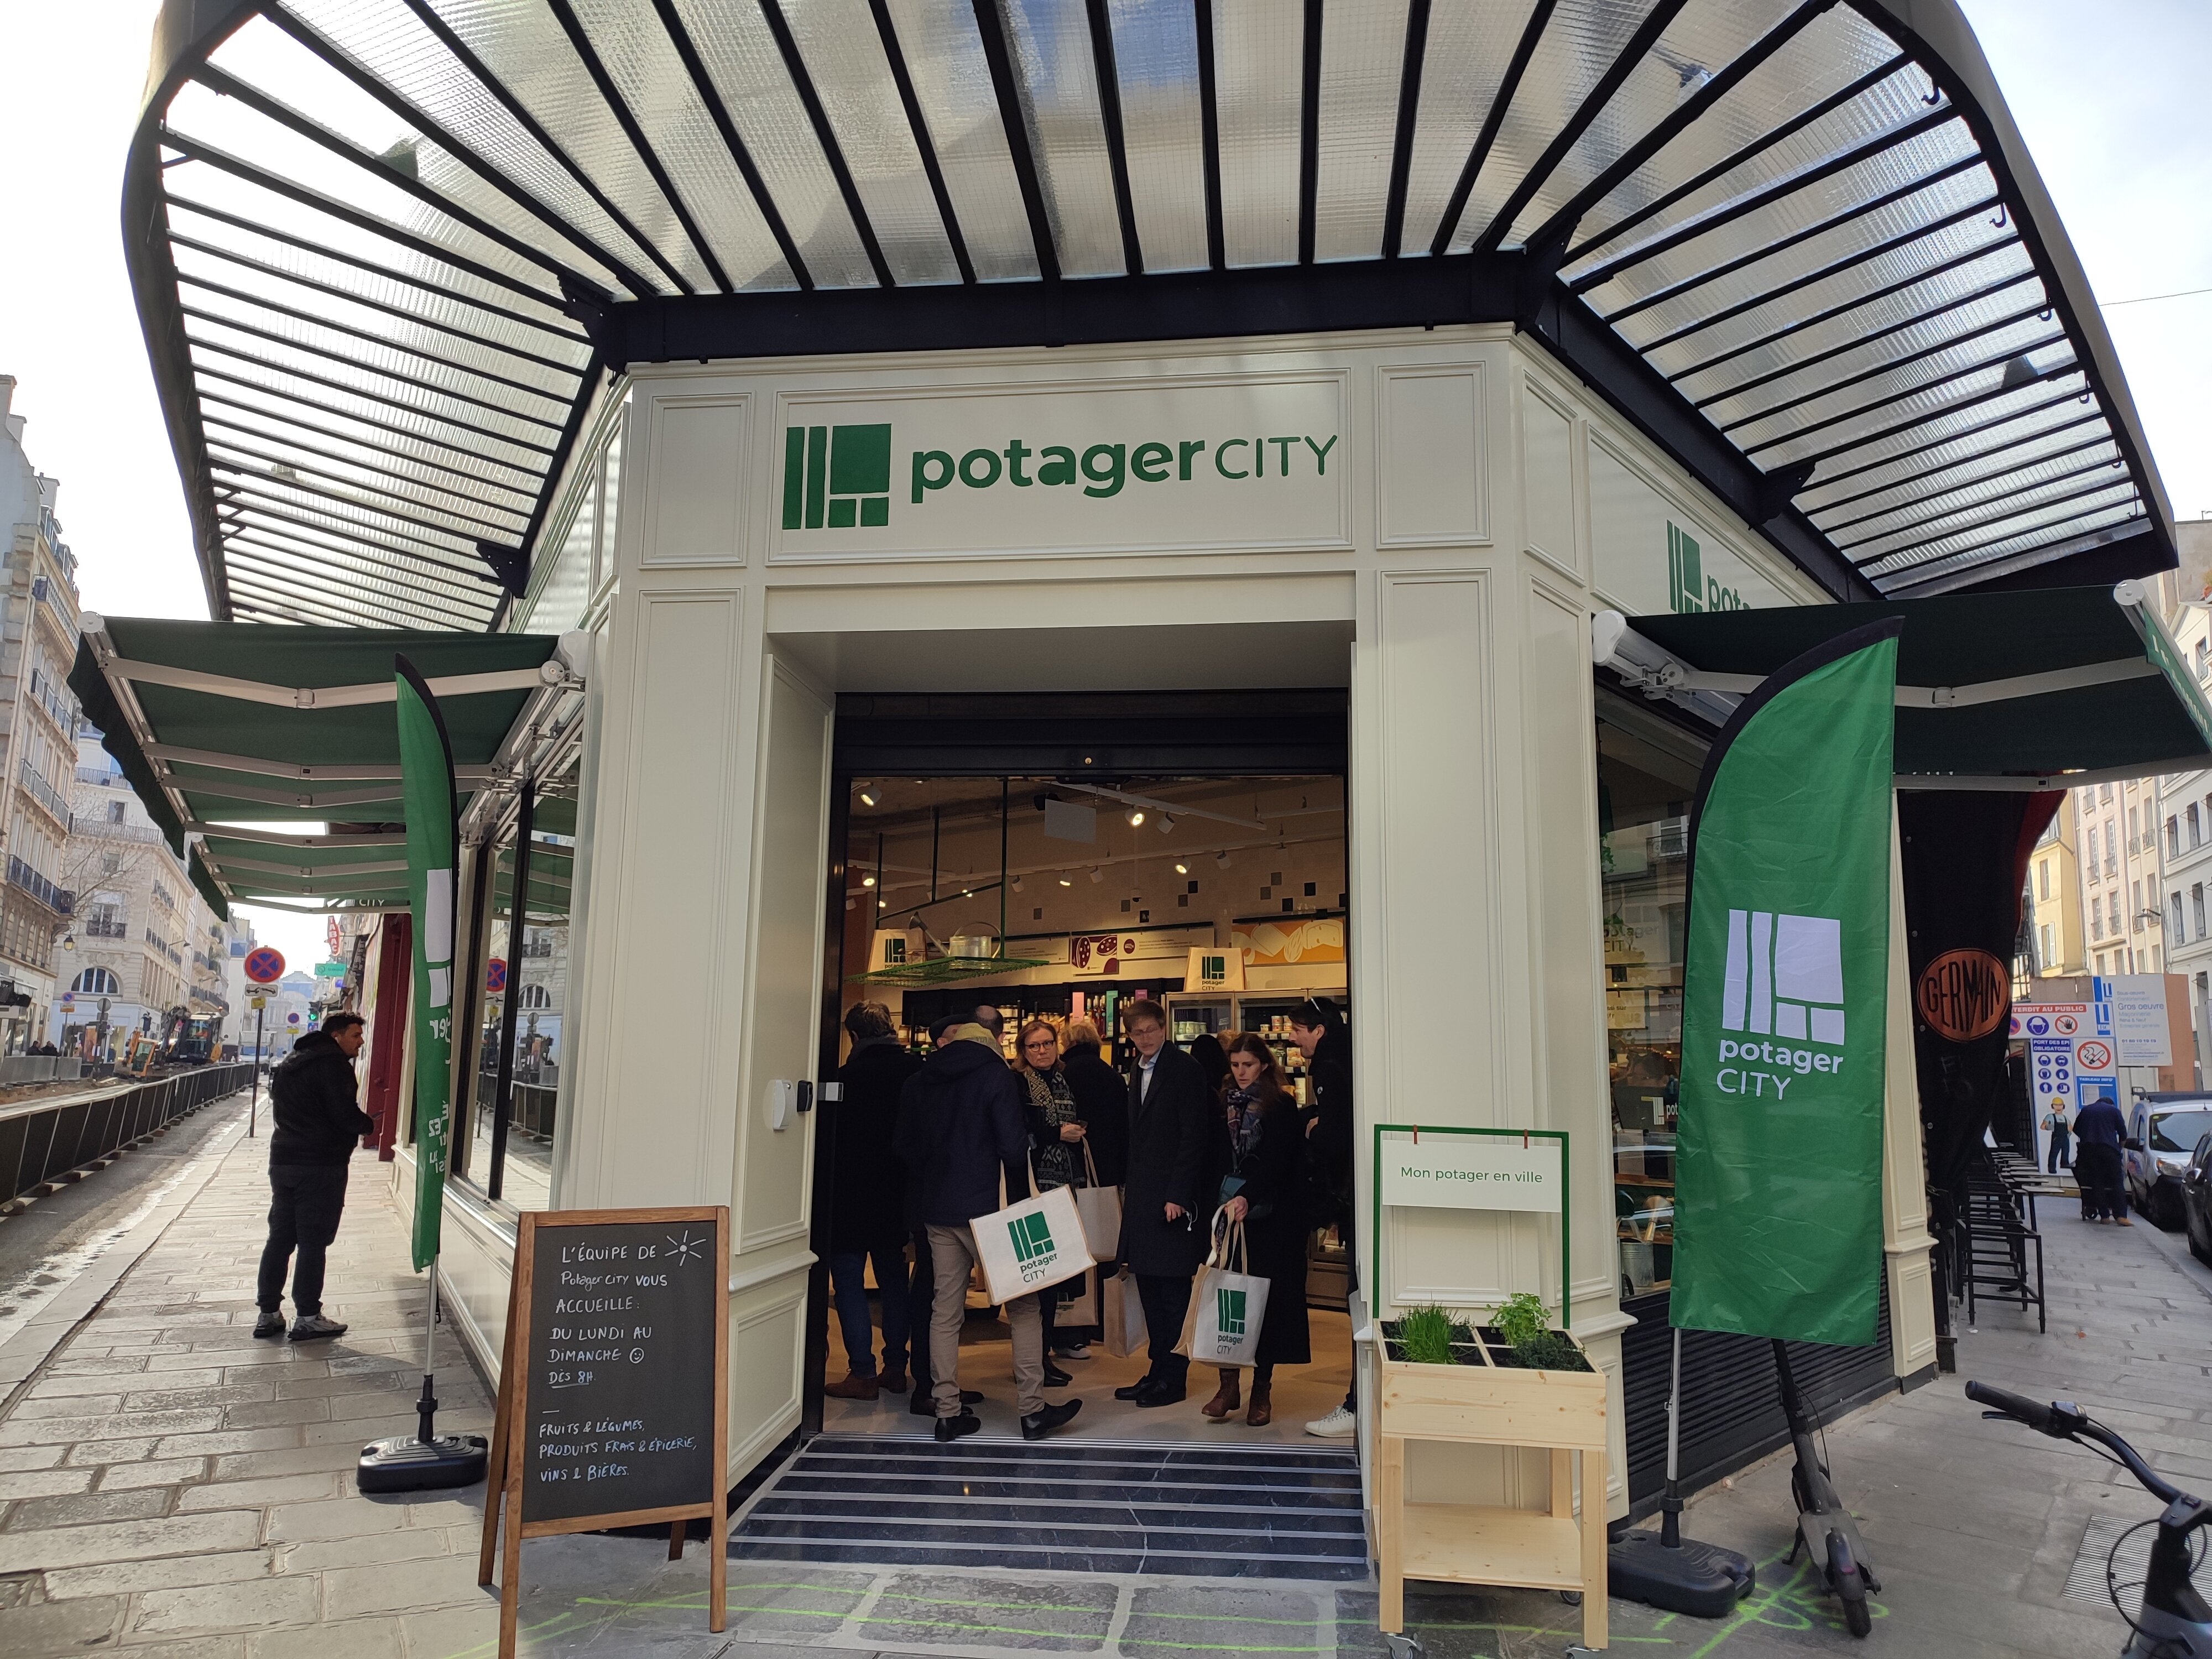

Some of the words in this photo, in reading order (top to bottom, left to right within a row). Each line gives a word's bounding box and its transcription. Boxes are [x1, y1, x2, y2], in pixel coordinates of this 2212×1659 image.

[911, 439, 1205, 504] potager
[1215, 434, 1338, 480] CITY
[1707, 575, 1751, 612] pot
[1719, 1039, 1844, 1074] potager
[1717, 1068, 1791, 1100] CITY
[1401, 1166, 1430, 1178] Mon
[1436, 1168, 1489, 1183] potager
[1493, 1172, 1510, 1182] en
[1515, 1171, 1543, 1183] ville
[638, 1245, 656, 1260] DE
[1020, 1253, 1058, 1274] potager
[635, 1274, 668, 1286] VOUS
[1023, 1268, 1046, 1283] CITY
[549, 1327, 572, 1340] DU
[633, 1326, 652, 1339] AU
[1218, 1334, 1244, 1345] potager
[1217, 1345, 1232, 1354] CITY
[582, 1421, 592, 1433] &
[638, 1440, 646, 1452] &
